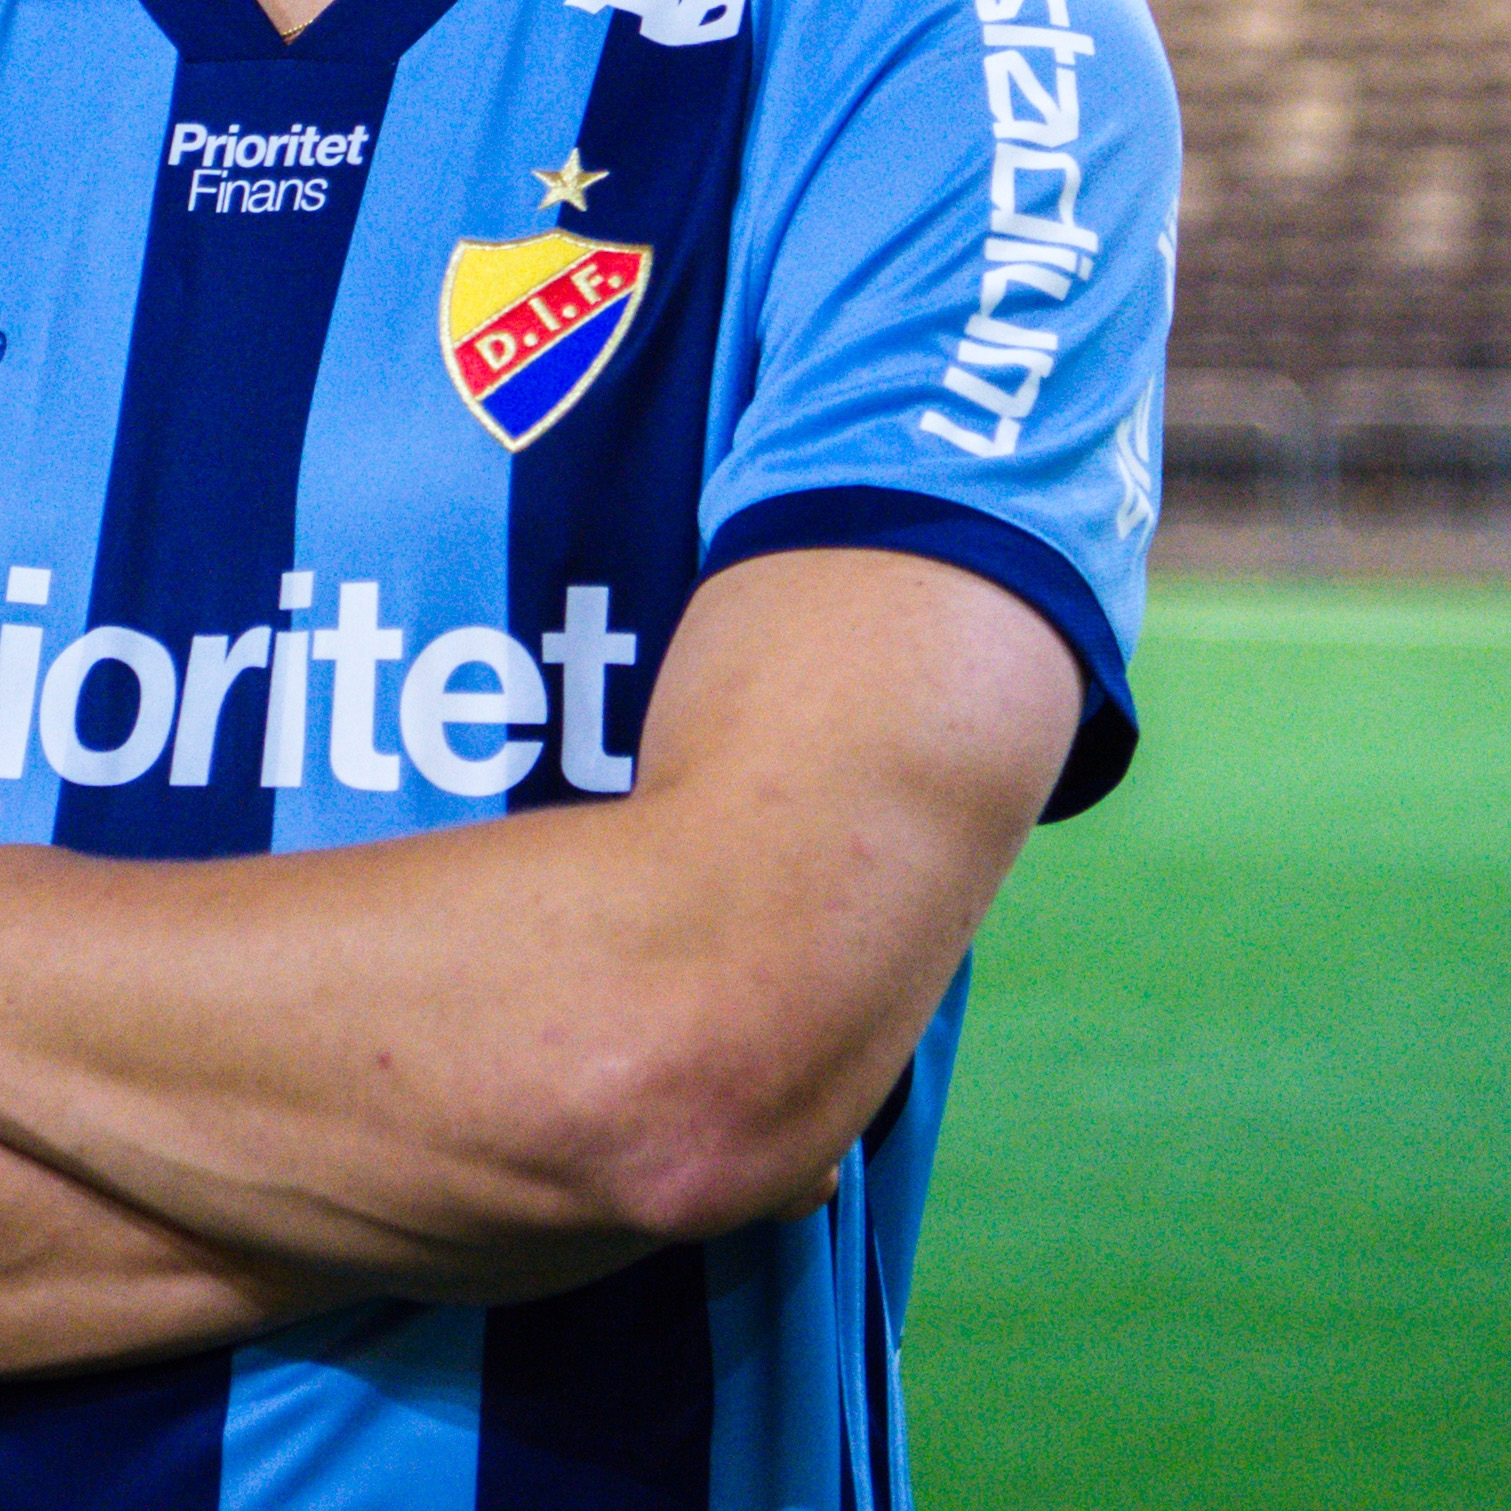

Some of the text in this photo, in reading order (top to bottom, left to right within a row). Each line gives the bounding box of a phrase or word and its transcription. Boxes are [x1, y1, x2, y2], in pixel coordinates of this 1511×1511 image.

[168, 122, 369, 168] Prioritet
[188, 169, 328, 213] Finans
[474, 263, 624, 371] D.I.F.
